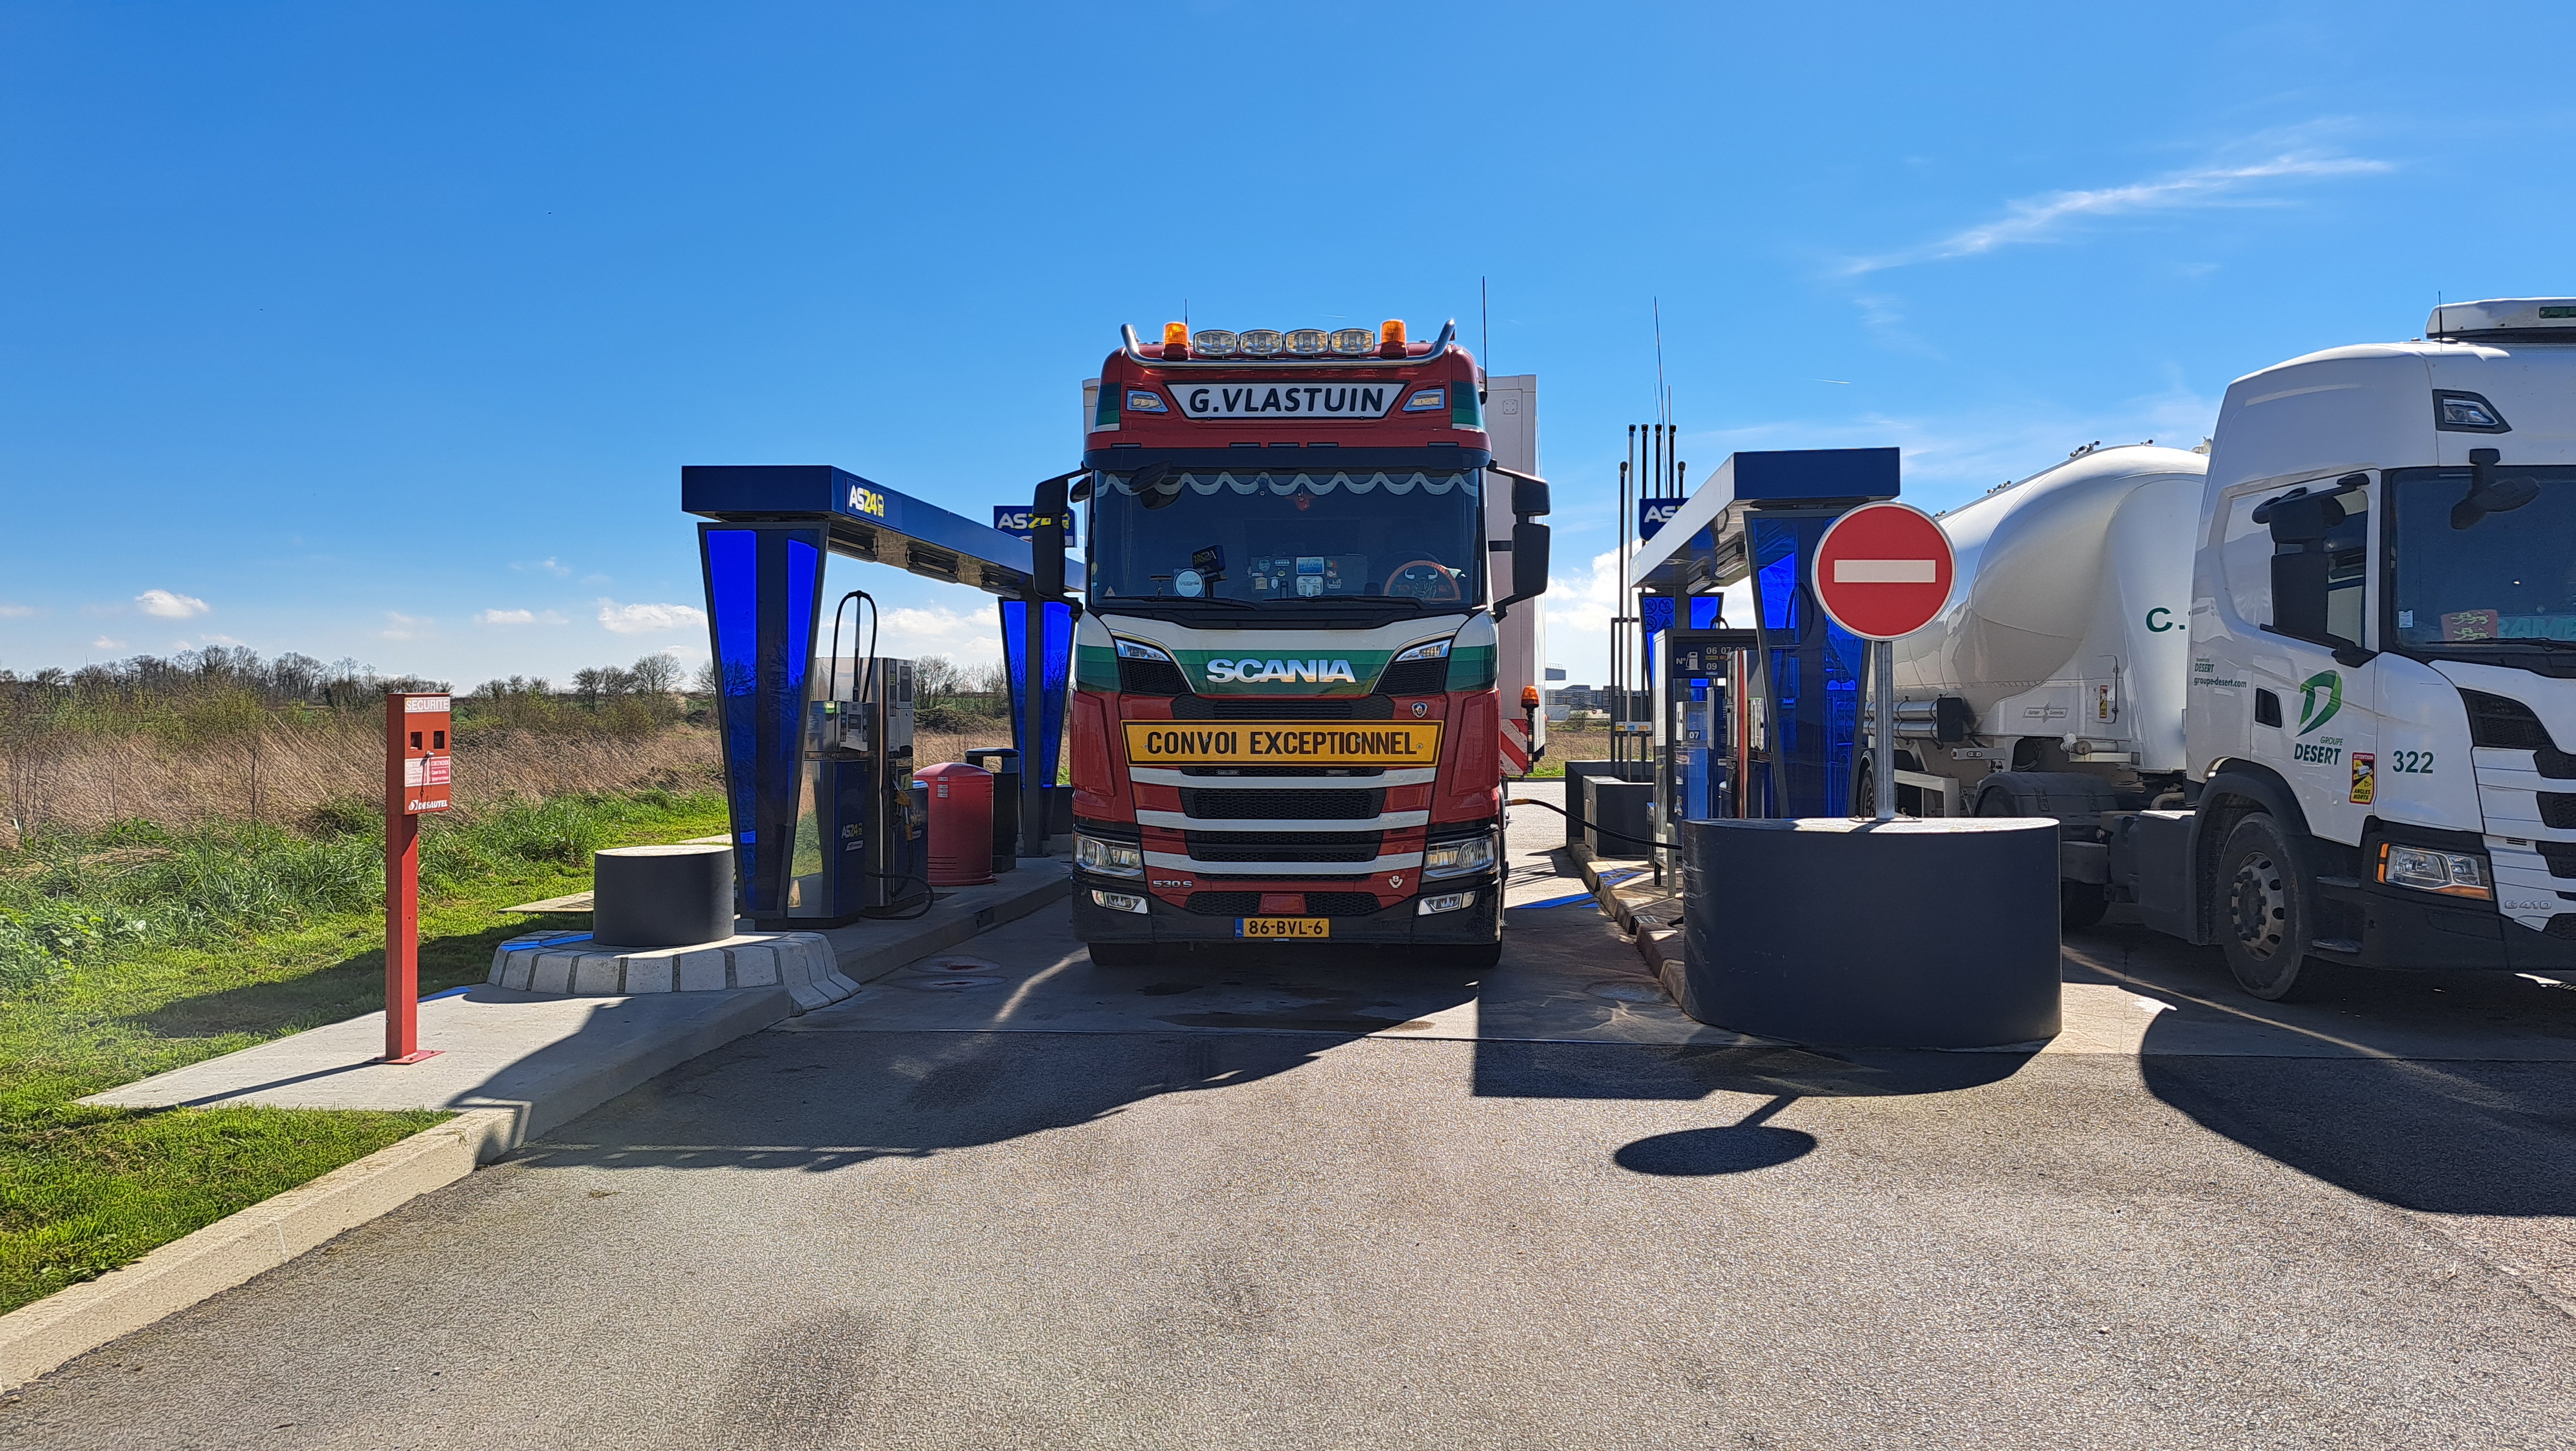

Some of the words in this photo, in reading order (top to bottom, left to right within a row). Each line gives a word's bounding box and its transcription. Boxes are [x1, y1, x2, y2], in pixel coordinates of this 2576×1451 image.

[1189, 388, 1383, 412] G.VLASTUIN
[849, 484, 877, 515] AS24
[1643, 505, 1683, 523] AS
[1706, 646, 1718, 655] 06
[1206, 659, 1357, 683] SCANIA
[1706, 662, 1718, 670] 09
[2194, 663, 2214, 673] DESERT
[2194, 676, 2247, 688] groupe-desert.com
[406, 699, 448, 710] SECURITE
[1147, 731, 1237, 754] CONVOI
[1250, 731, 1417, 754] EXCEPTIONNEL
[2320, 736, 2344, 746] GROUPE
[2294, 743, 2342, 766] DESERT
[2392, 750, 2434, 774] 322
[841, 824, 858, 839] AS24
[1153, 880, 1181, 888] 530
[2519, 900, 2552, 910] 410
[1248, 921, 1323, 935] 86-BVL-6
